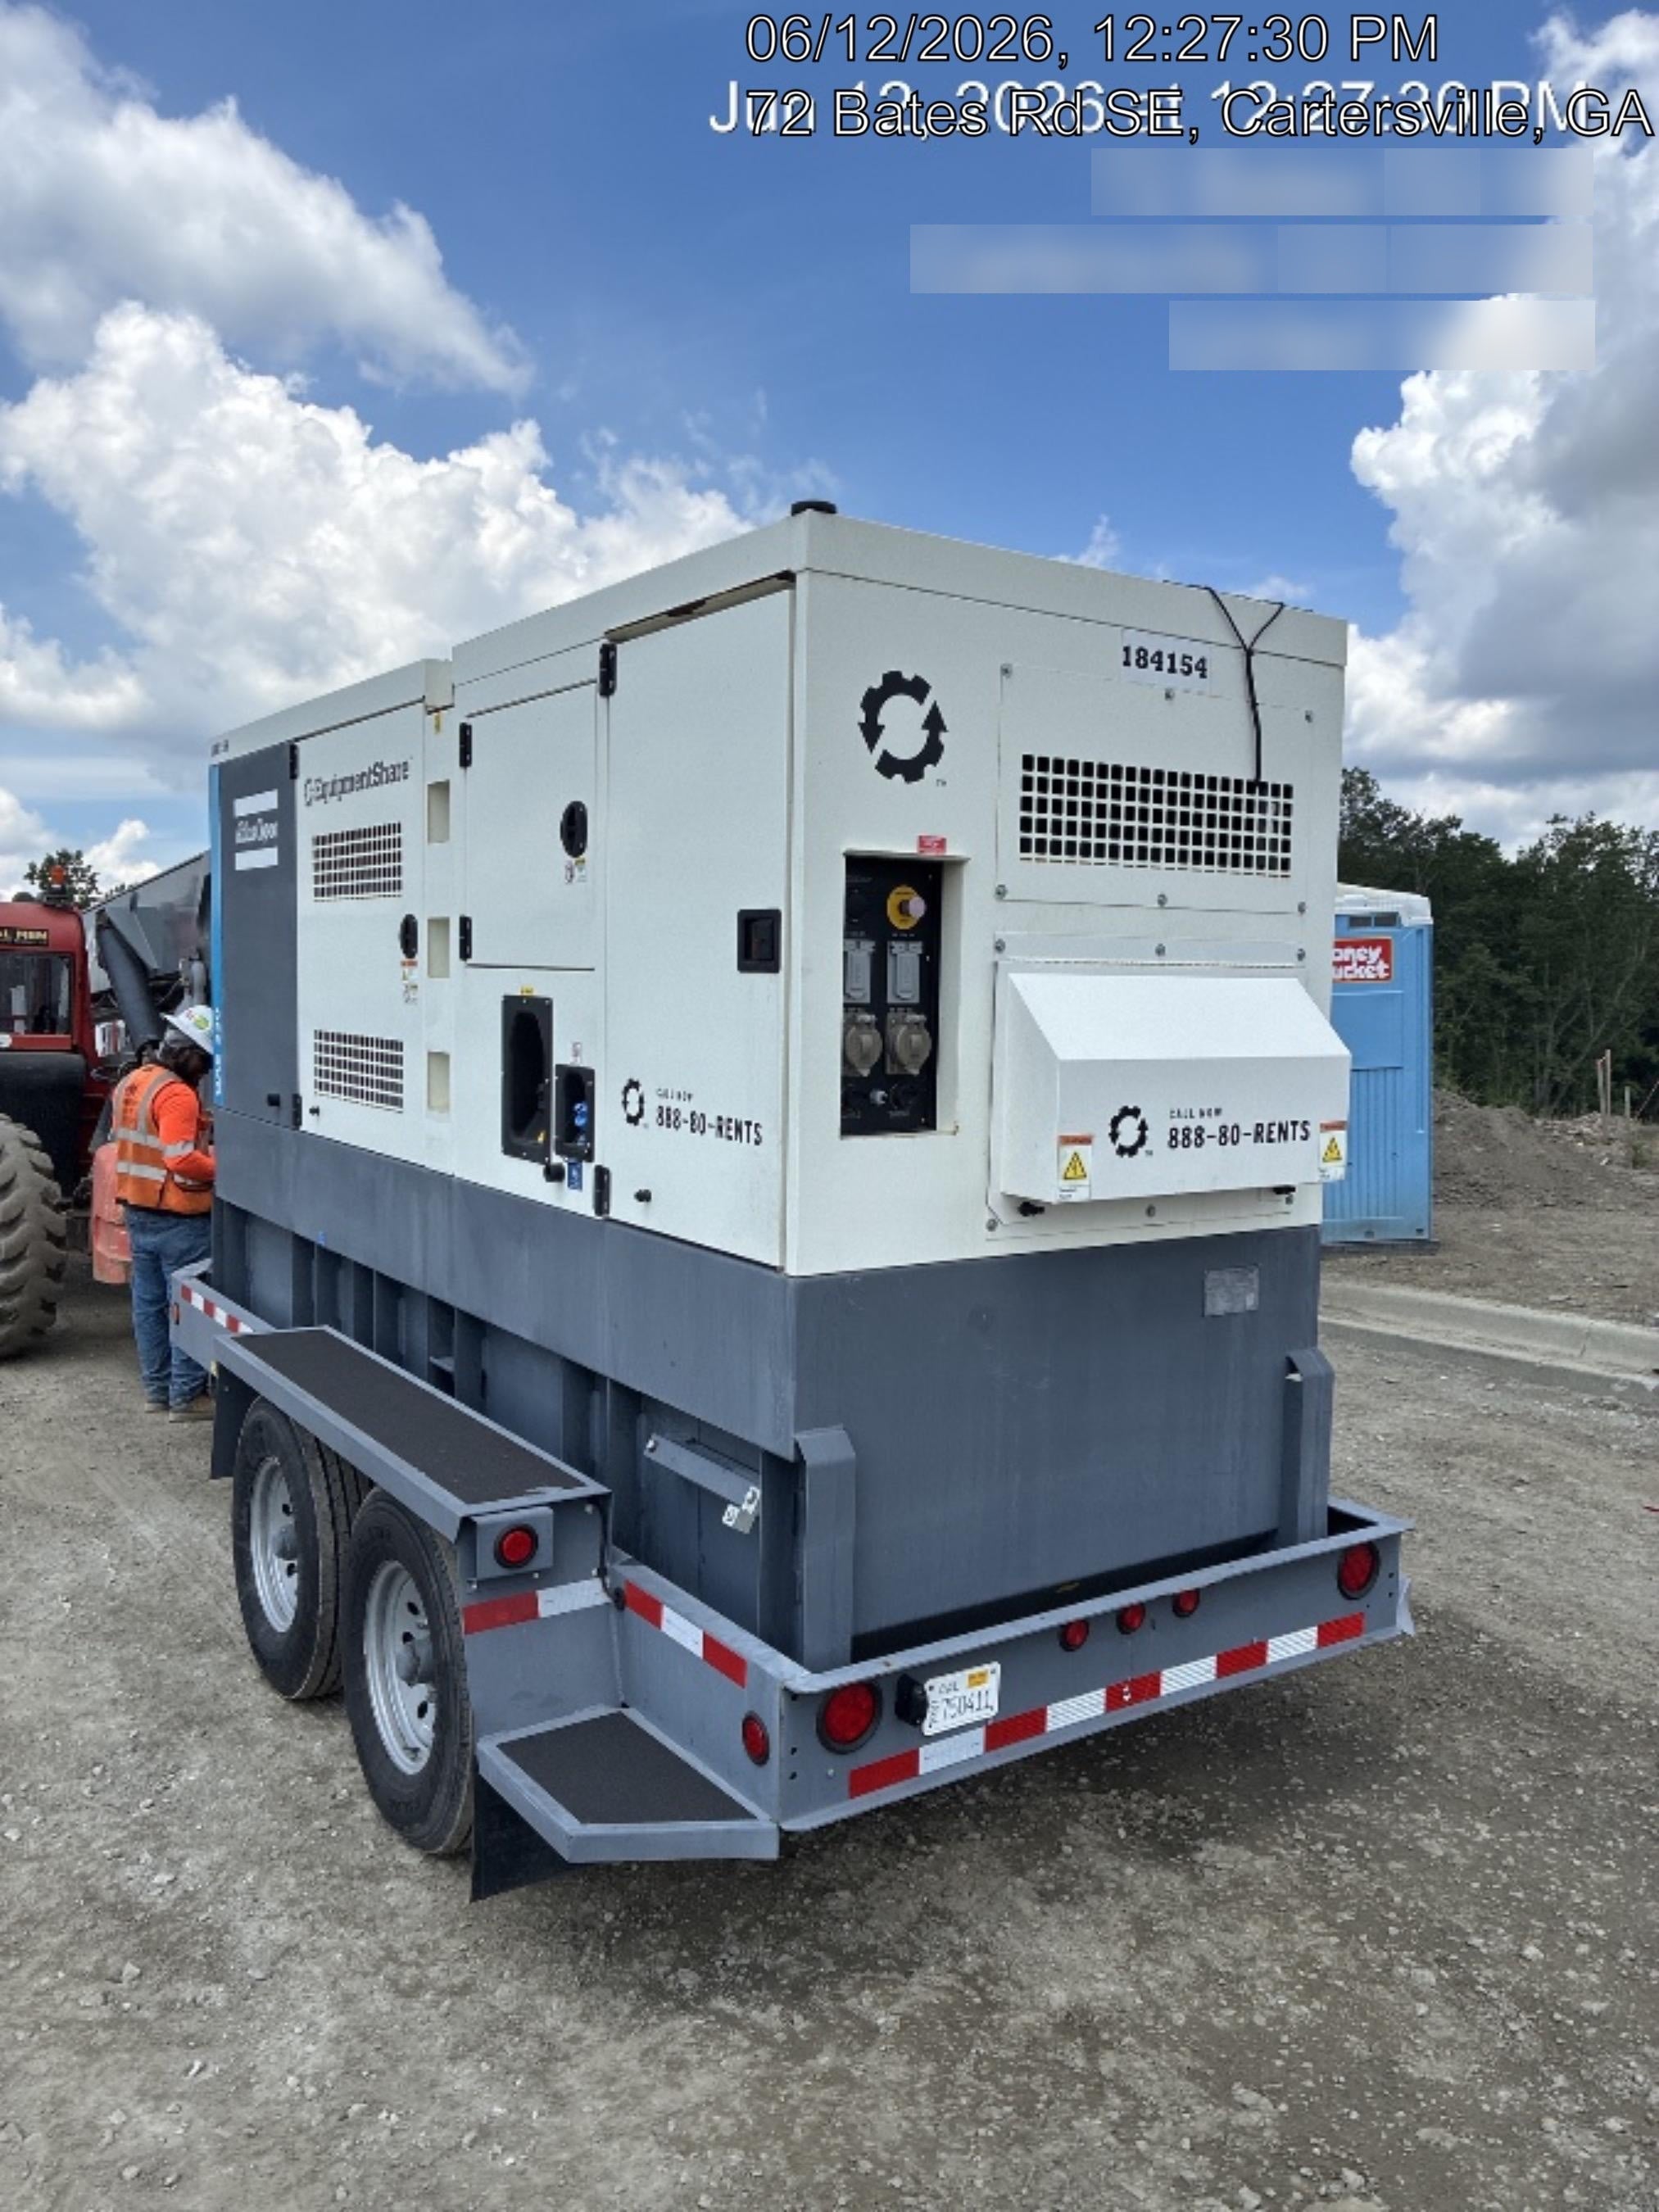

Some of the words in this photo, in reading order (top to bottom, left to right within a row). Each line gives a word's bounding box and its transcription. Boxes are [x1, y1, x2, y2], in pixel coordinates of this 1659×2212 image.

[1122, 646, 1208, 680] 184154
[1332, 945, 1383, 965] oney
[1332, 960, 1391, 979] ucket
[655, 1104, 764, 1146] 888-80-RENTS
[1167, 1118, 1312, 1150] 888-80-RENTS
